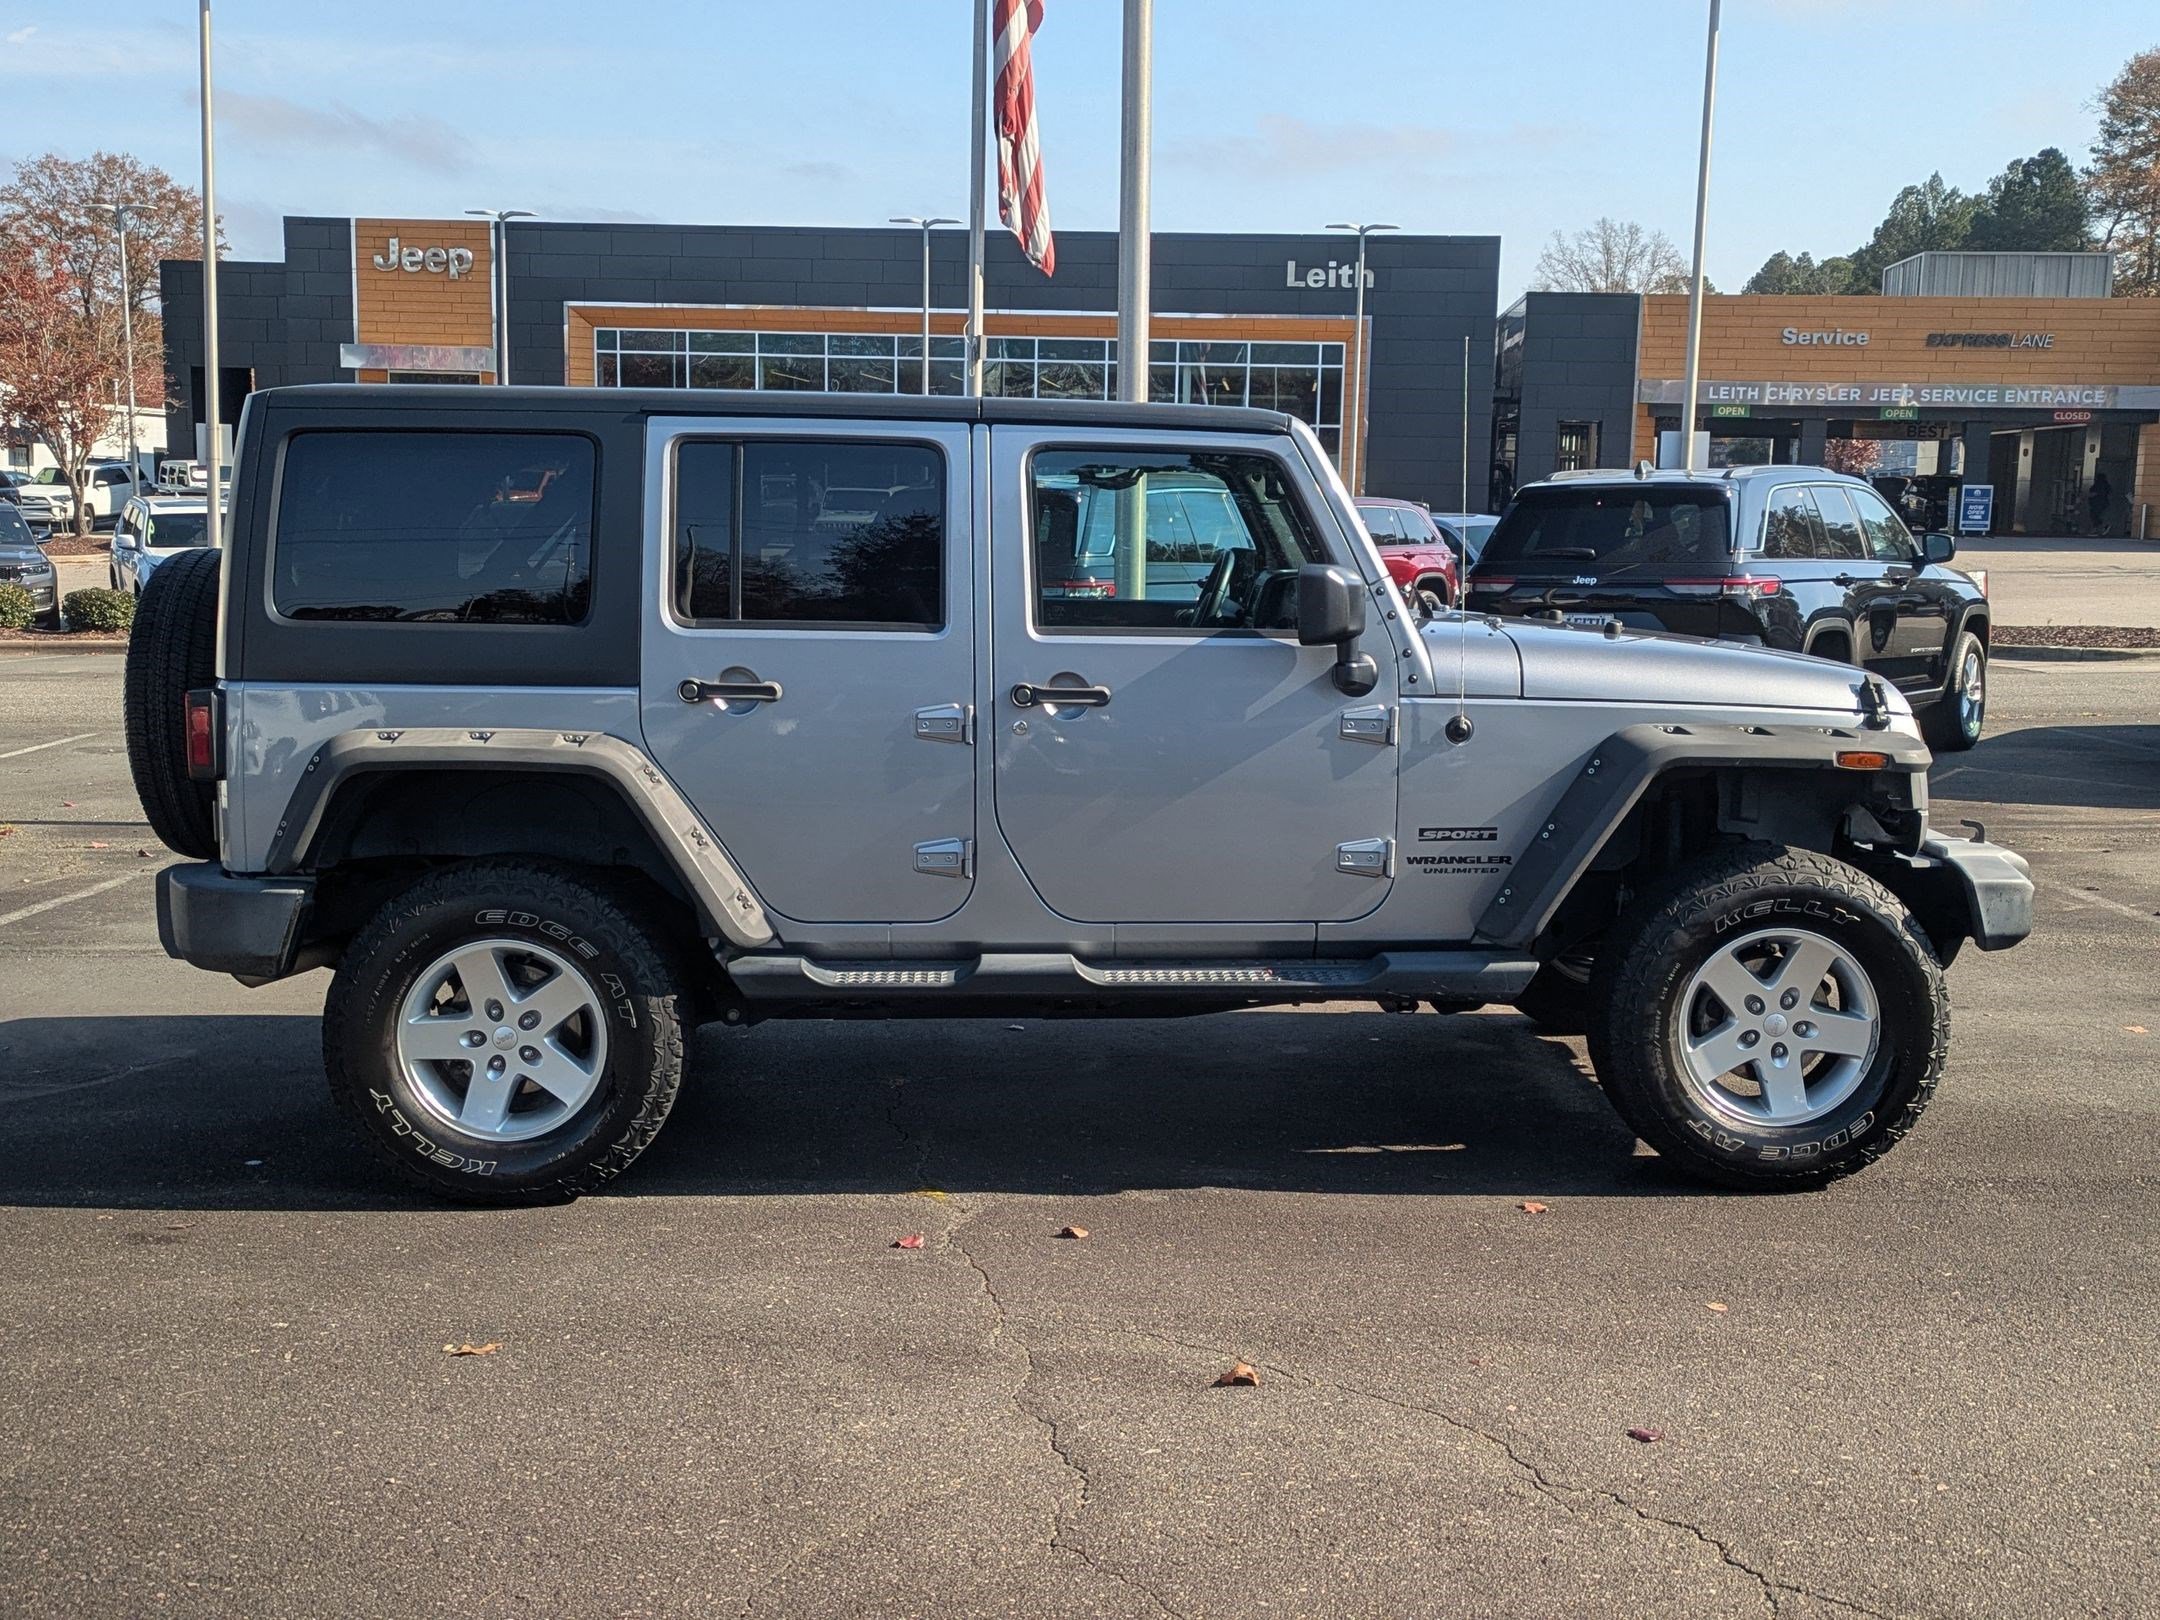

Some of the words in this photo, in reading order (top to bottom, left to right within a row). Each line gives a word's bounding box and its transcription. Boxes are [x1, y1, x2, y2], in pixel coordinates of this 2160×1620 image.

[373, 237, 473, 280] Jeep
[1286, 260, 1375, 288] Leith
[1782, 327, 1870, 346] Service
[1708, 386, 1759, 399] LEITH
[1767, 387, 1861, 401] CHRYSLER
[1869, 388, 1914, 401] JEEP
[1920, 389, 1998, 402] SERVICE
[2005, 389, 2105, 403] ENTRANCE
[1718, 406, 1745, 416] OPEN
[1885, 408, 1913, 418] OPEN
[2054, 411, 2091, 420] CLOSED
[1906, 426, 1948, 438] BEST
[1572, 575, 1597, 586] Jeep
[1419, 829, 1498, 840] SPORT
[1406, 855, 1513, 865] WRANGLER
[1714, 898, 1861, 934] KELLY
[474, 909, 600, 960] EDGE
[600, 973, 638, 1029] AT
[369, 1088, 497, 1176] KELLY
[1686, 1119, 1746, 1152] AT
[1758, 1110, 1875, 1161] EDGE
